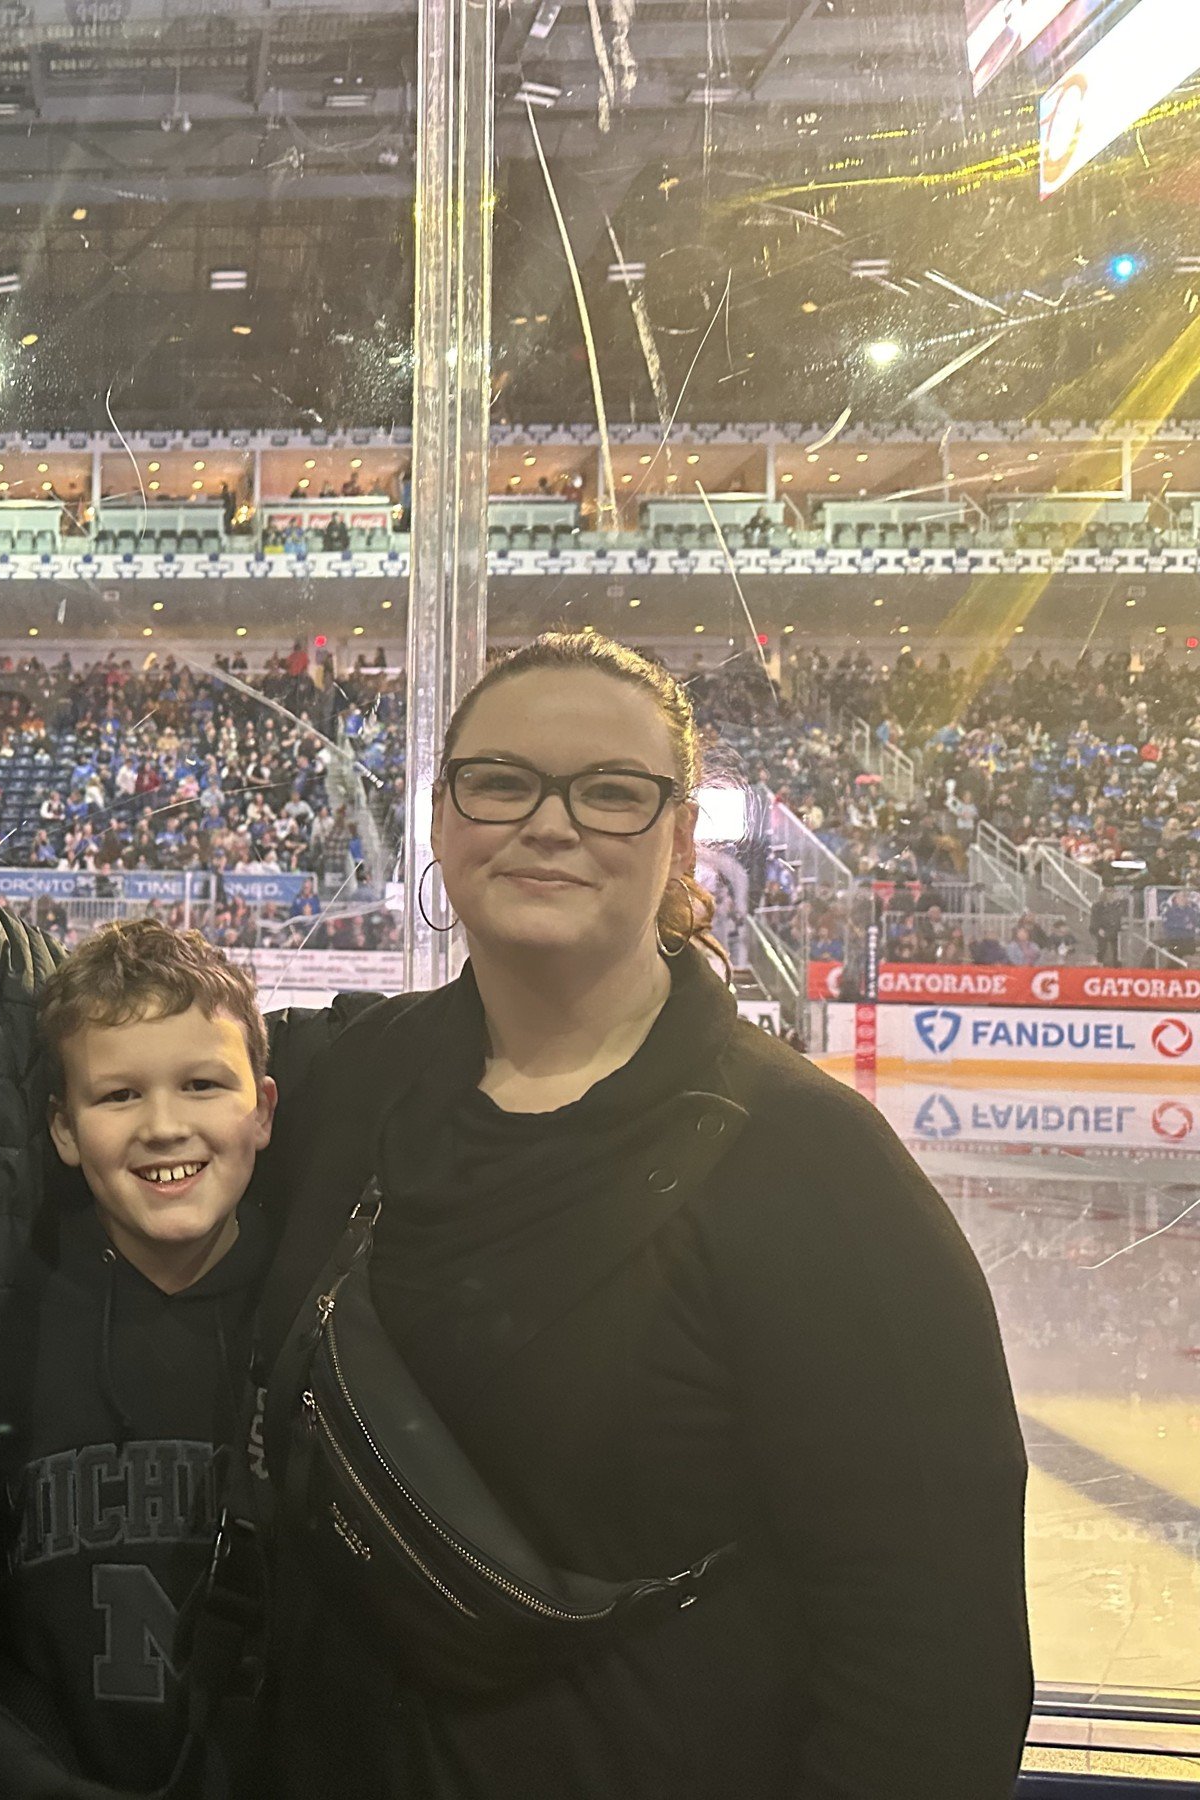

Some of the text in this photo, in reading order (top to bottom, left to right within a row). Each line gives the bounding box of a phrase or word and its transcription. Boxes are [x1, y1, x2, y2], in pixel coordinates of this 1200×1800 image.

[878, 973, 1007, 994] GATORADE
[1031, 970, 1059, 1000] G
[972, 1021, 1135, 1049] FANDUEL
